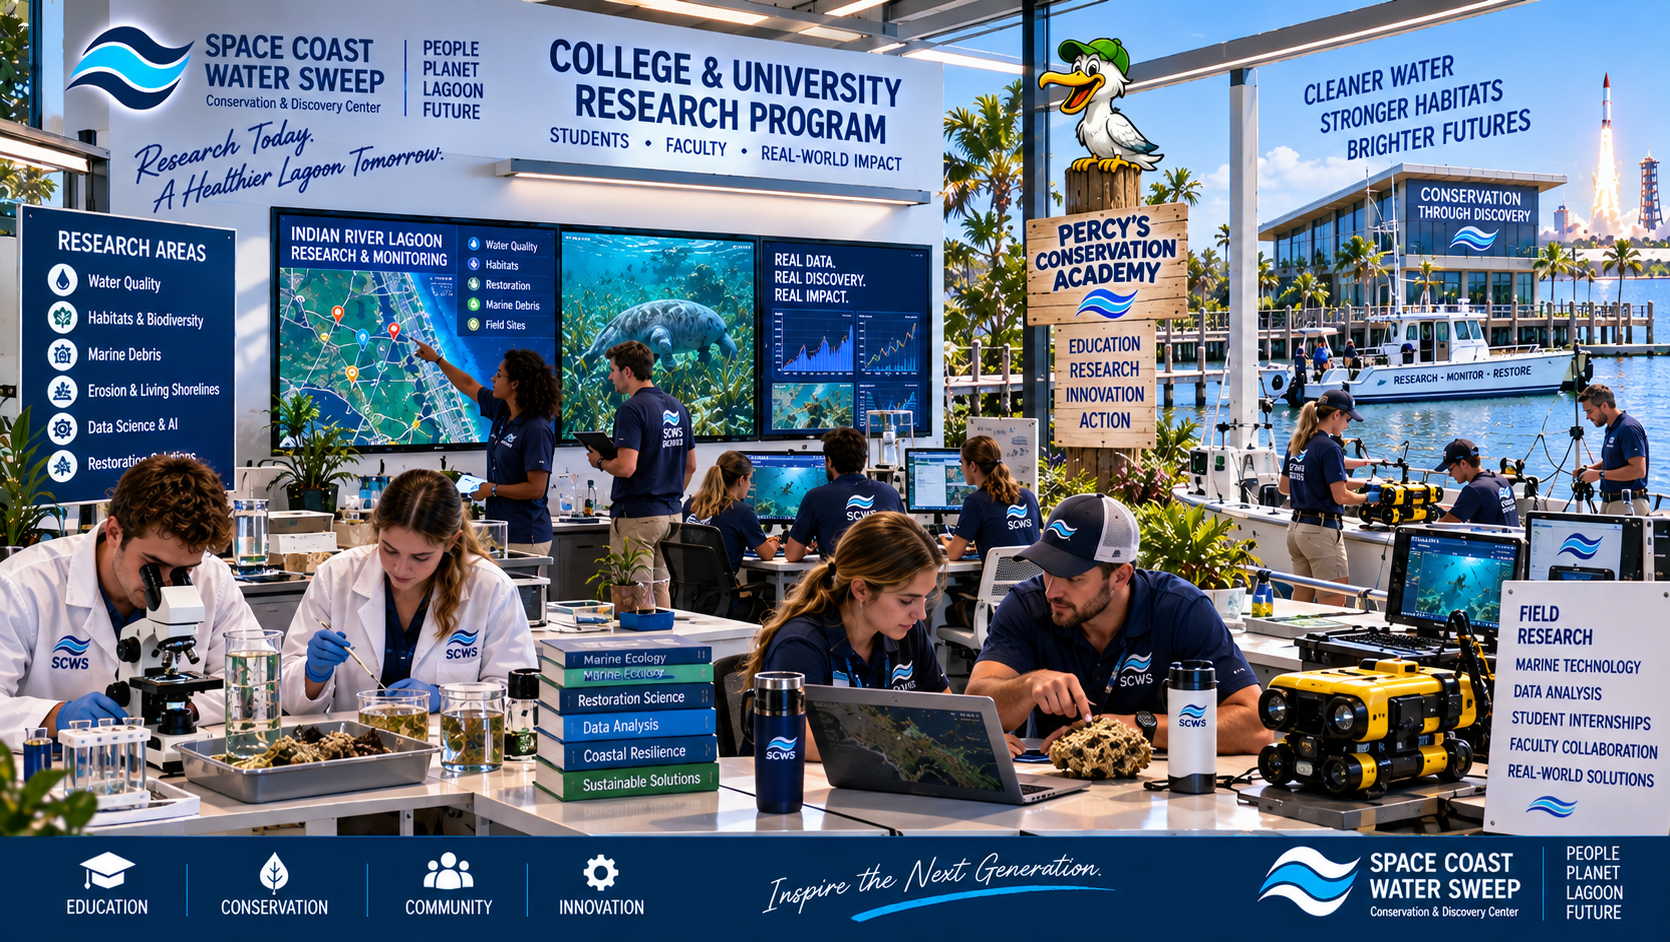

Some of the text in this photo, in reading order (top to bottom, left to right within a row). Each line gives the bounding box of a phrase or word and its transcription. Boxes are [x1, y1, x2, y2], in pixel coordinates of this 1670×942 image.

[205, 33, 374, 63] SPACE COAST
[423, 40, 479, 57] PEOPLE
[423, 60, 478, 78] PLANET
[550, 39, 902, 107] COLLEGE & UNIVERSITY
[205, 63, 385, 94] WATER SWEEP
[423, 81, 484, 99] LAGOON
[206, 94, 381, 115] Conservation & Discovery Center
[423, 101, 480, 120] FUTURE
[576, 84, 886, 144] RESEARCH PROGRAM
[135, 120, 315, 184] Research Today.
[550, 127, 903, 171] STUDENTS FACULTY REAL-WORLD IMPACT
[153, 180, 175, 213] A
[183, 163, 272, 207] Healthier
[278, 156, 345, 193] Lagoon
[1420, 186, 1521, 206] CONSERVATION
[1418, 205, 1531, 222] THROUGH DISCOVERY
[291, 226, 442, 248] INDIAN RIVER LAGOON
[1058, 214, 1150, 247] PERCY'S
[58, 230, 207, 262] RESEARCH AREAS
[486, 239, 538, 253] Water Quality
[291, 246, 447, 267] RESEARCH & MONITORING
[774, 253, 836, 269] REAL DATA.
[1035, 239, 1176, 271] CONSERVATION
[486, 260, 519, 271] Habitats
[88, 274, 161, 294] Water Quality
[774, 270, 866, 287] REAL DISCOVERY.
[1052, 261, 1162, 292] ACADEMY
[486, 280, 531, 291] Restoration
[774, 288, 849, 304] REAL IMPACT.
[486, 300, 540, 311] Marine Debris
[88, 311, 204, 330] Habitats & Biodiversity
[486, 320, 526, 330] Field Sites
[1069, 335, 1141, 354] EDUCATION
[88, 348, 162, 362] Marine Debris
[1070, 361, 1140, 378] RESEARCH
[1393, 365, 1531, 385] RESEARCH MONITOR RESTORE
[88, 383, 220, 399] Erosion & Living Shorelines
[1066, 386, 1145, 403] INNOVATION
[88, 418, 178, 434] Data Science & AI
[1079, 411, 1131, 429] ACTION
[1007, 518, 1032, 531] SCWS
[1519, 605, 1559, 622] FIELD
[1517, 628, 1593, 646] RESEARCH
[445, 646, 478, 660] SCWS
[584, 652, 667, 665] Marine Ecology
[51, 656, 89, 670] SCWS
[1516, 658, 1642, 675] MARINE TECHNOLOGY
[1120, 673, 1153, 687] SCWS
[578, 691, 685, 707] Restoration Science
[1514, 684, 1602, 701] DATA ANALYSIS
[583, 718, 659, 735] Data Analysis
[1179, 718, 1207, 728] SCWS
[1512, 710, 1652, 731] STUDENT INTERNSHIPS
[584, 746, 686, 763] Coastal Resilience
[765, 751, 796, 761] SCWS
[1510, 737, 1658, 760] FACULTY COLLABORATION
[583, 772, 701, 793] Sustainable Solutions
[1508, 764, 1655, 788] REAL-WORLD SOLUTIONS
